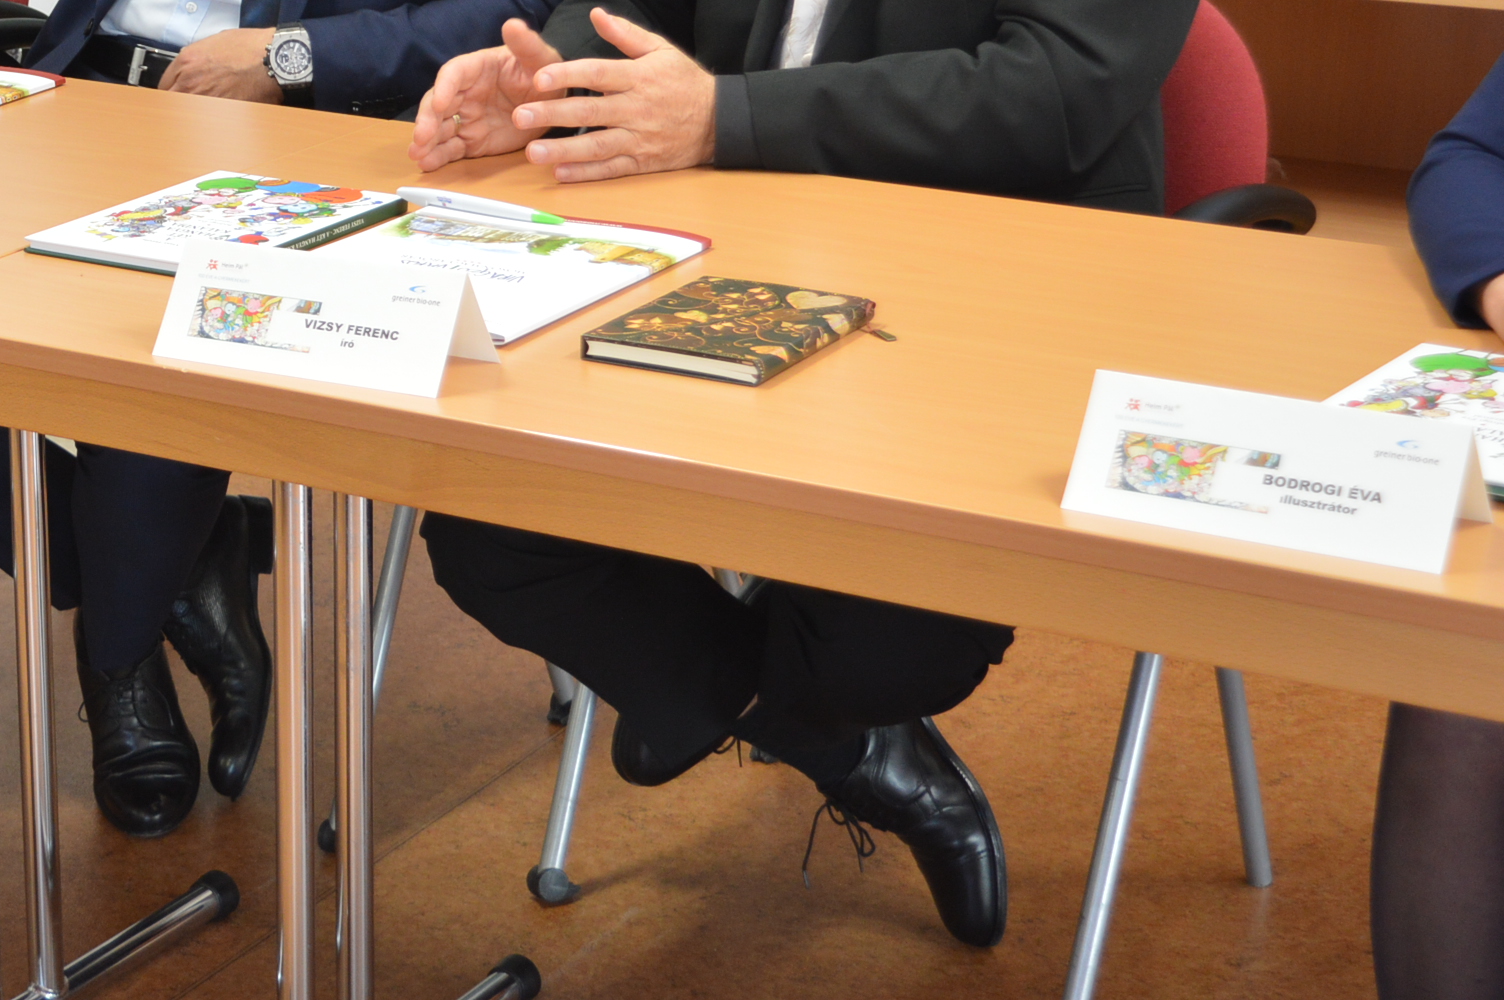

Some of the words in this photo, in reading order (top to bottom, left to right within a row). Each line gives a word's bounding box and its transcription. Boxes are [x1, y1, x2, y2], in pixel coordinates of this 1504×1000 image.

[391, 293, 416, 305] greiner
[304, 318, 343, 333] VIZSY
[346, 324, 400, 341] FERENC
[339, 338, 355, 349] író
[1373, 449, 1405, 462] greiner
[1262, 474, 1342, 498] BODROGI
[1348, 484, 1383, 504] ÉVA
[1279, 495, 1358, 516] illusztrátor
